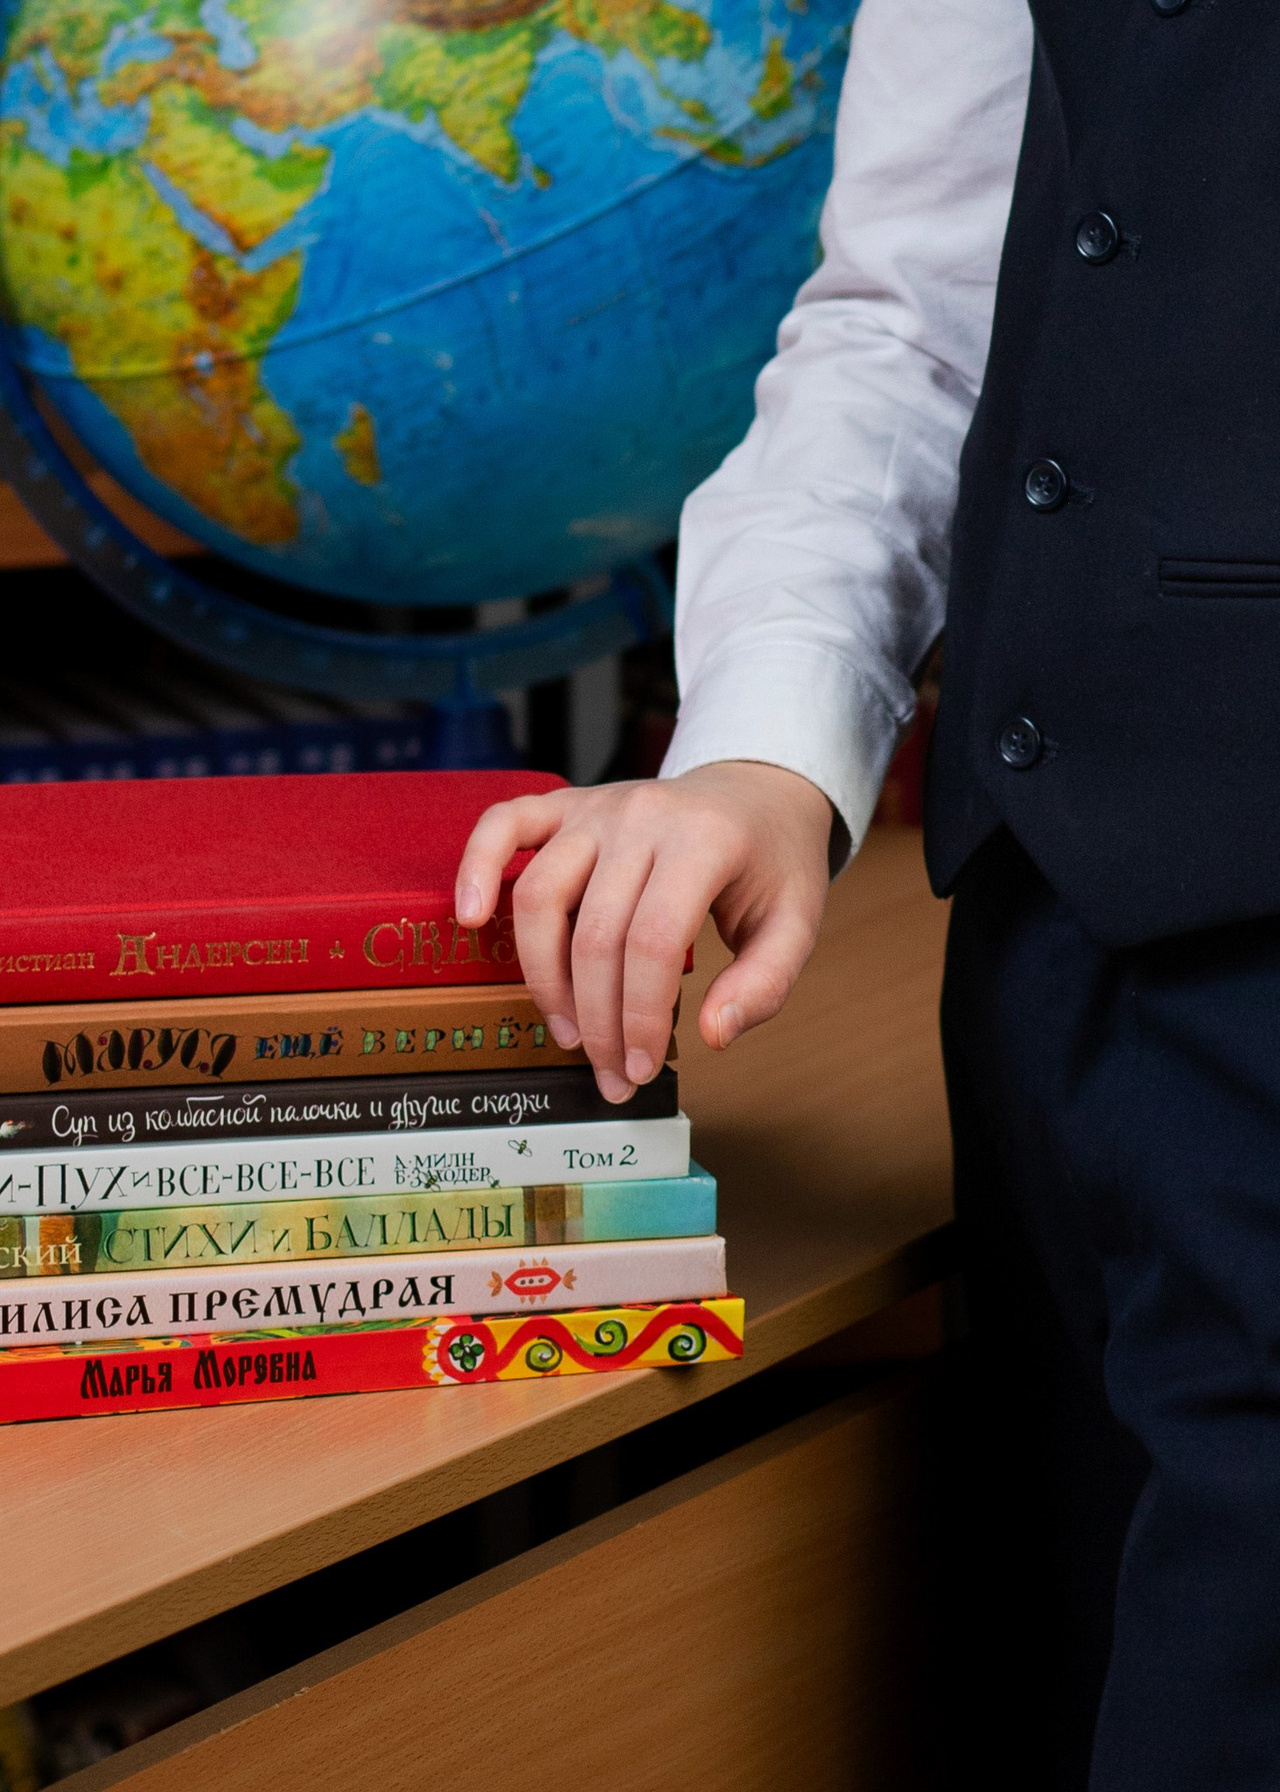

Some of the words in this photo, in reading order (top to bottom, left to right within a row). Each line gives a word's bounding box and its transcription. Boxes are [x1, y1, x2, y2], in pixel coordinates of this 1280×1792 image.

[52, 1104, 98, 1147] Суп
[108, 1111, 135, 1142] из
[146, 1094, 266, 1130] колбасной
[271, 1101, 361, 1124] палочки
[370, 1099, 384, 1117] и
[388, 1092, 463, 1130] другие
[471, 1092, 551, 1124] сказки
[619, 1144, 638, 1166] 2
[103, 1219, 258, 1264] СТИХИ
[305, 1203, 516, 1253] БАЛЛАДЫ
[169, 1274, 456, 1324] ПРЕМУДРАЯ
